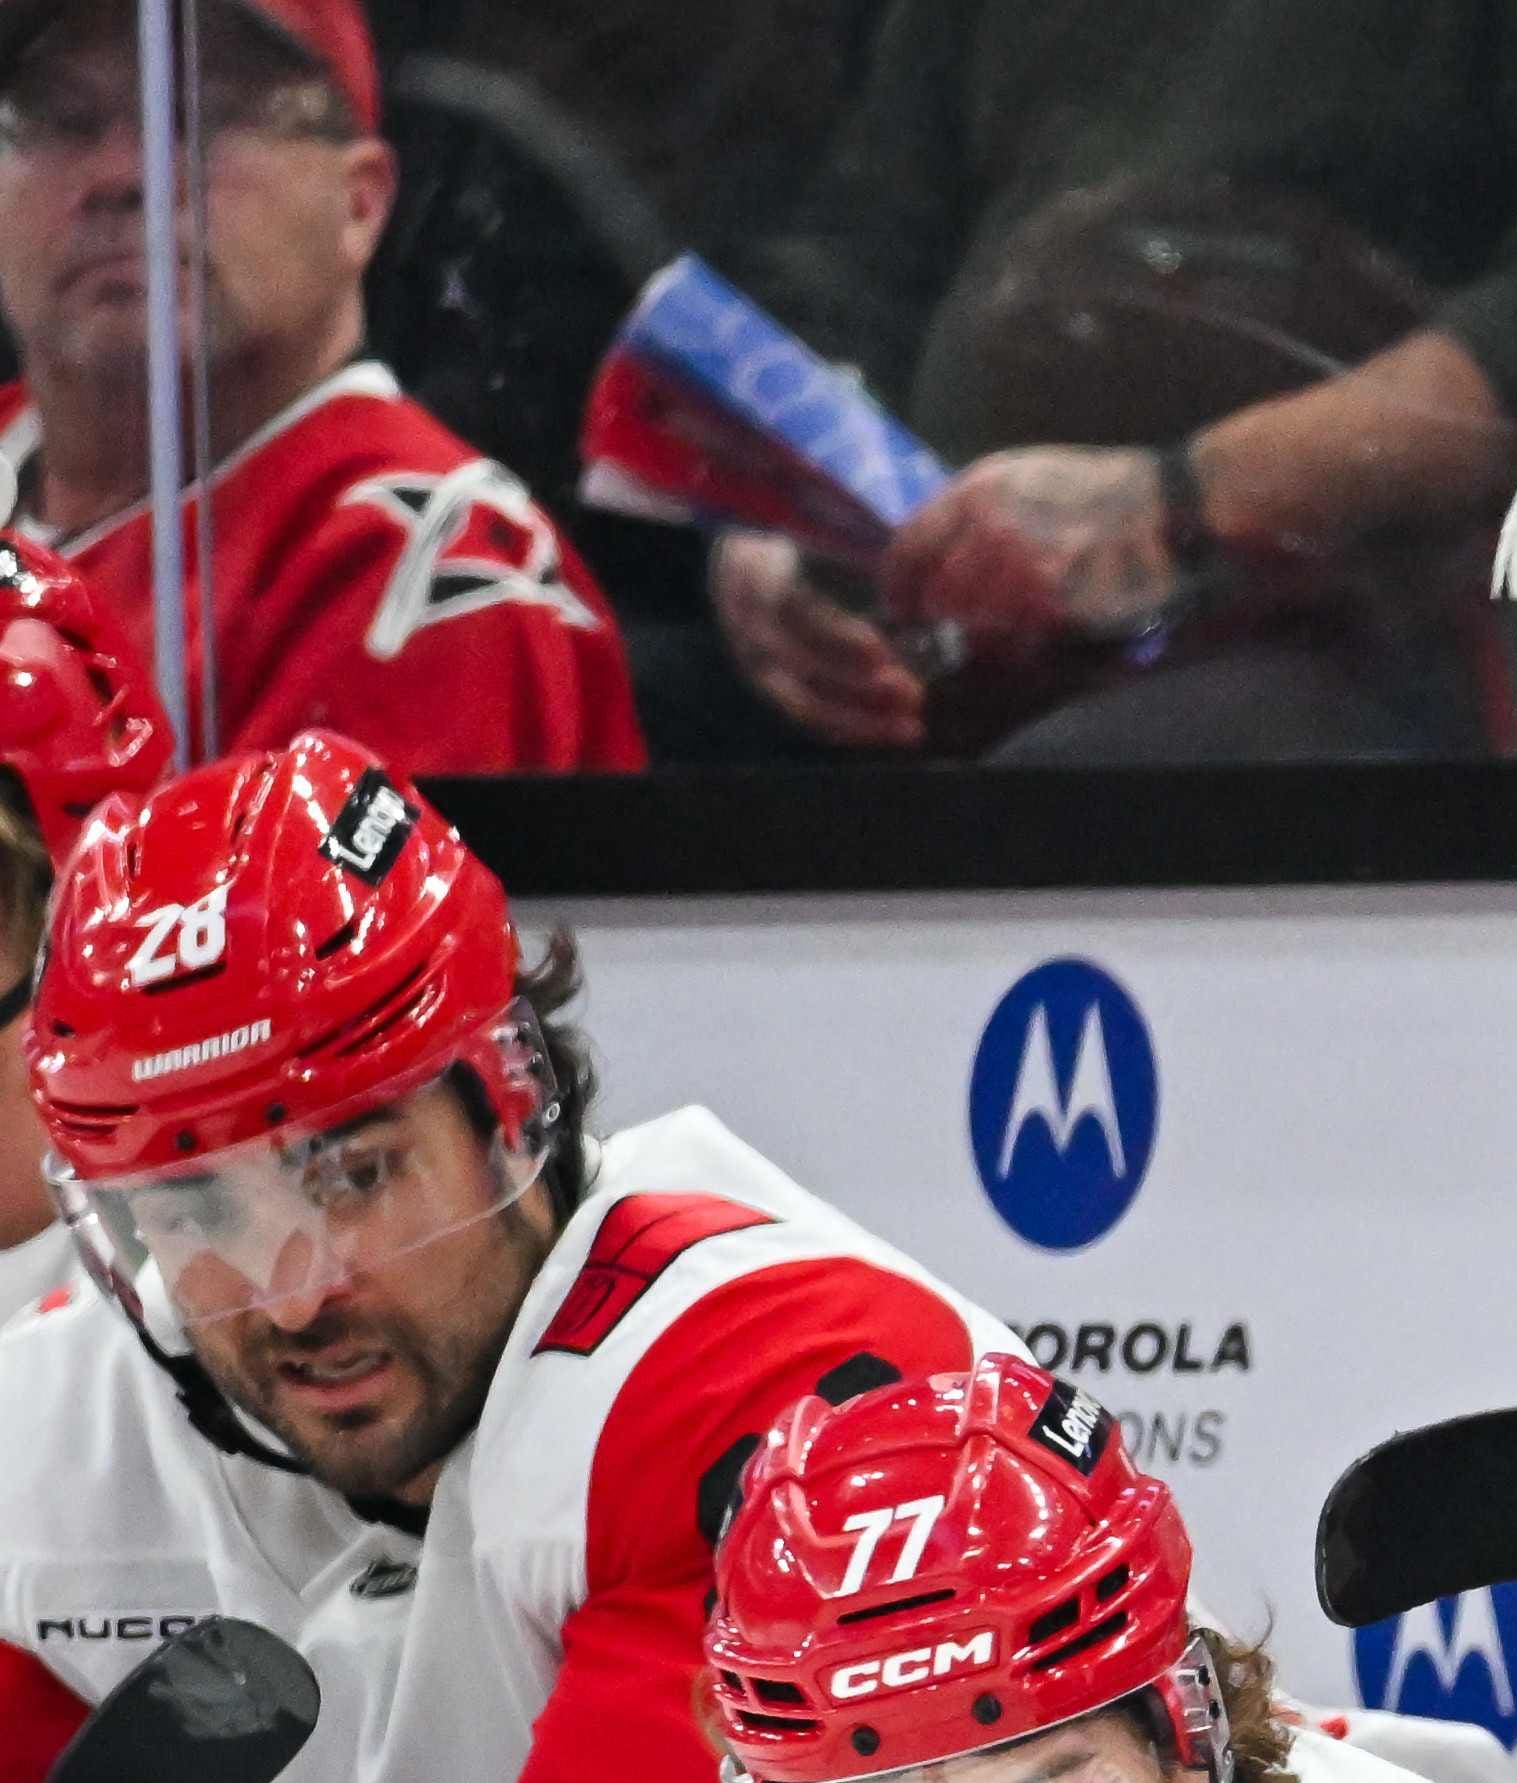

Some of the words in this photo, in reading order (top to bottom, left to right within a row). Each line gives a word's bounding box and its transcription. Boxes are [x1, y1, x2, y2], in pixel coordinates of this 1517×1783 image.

[125, 884, 230, 987] 28
[1008, 1322, 1253, 1373] OROLA
[832, 1495, 945, 1597] 77
[831, 1631, 995, 1699] CCM
